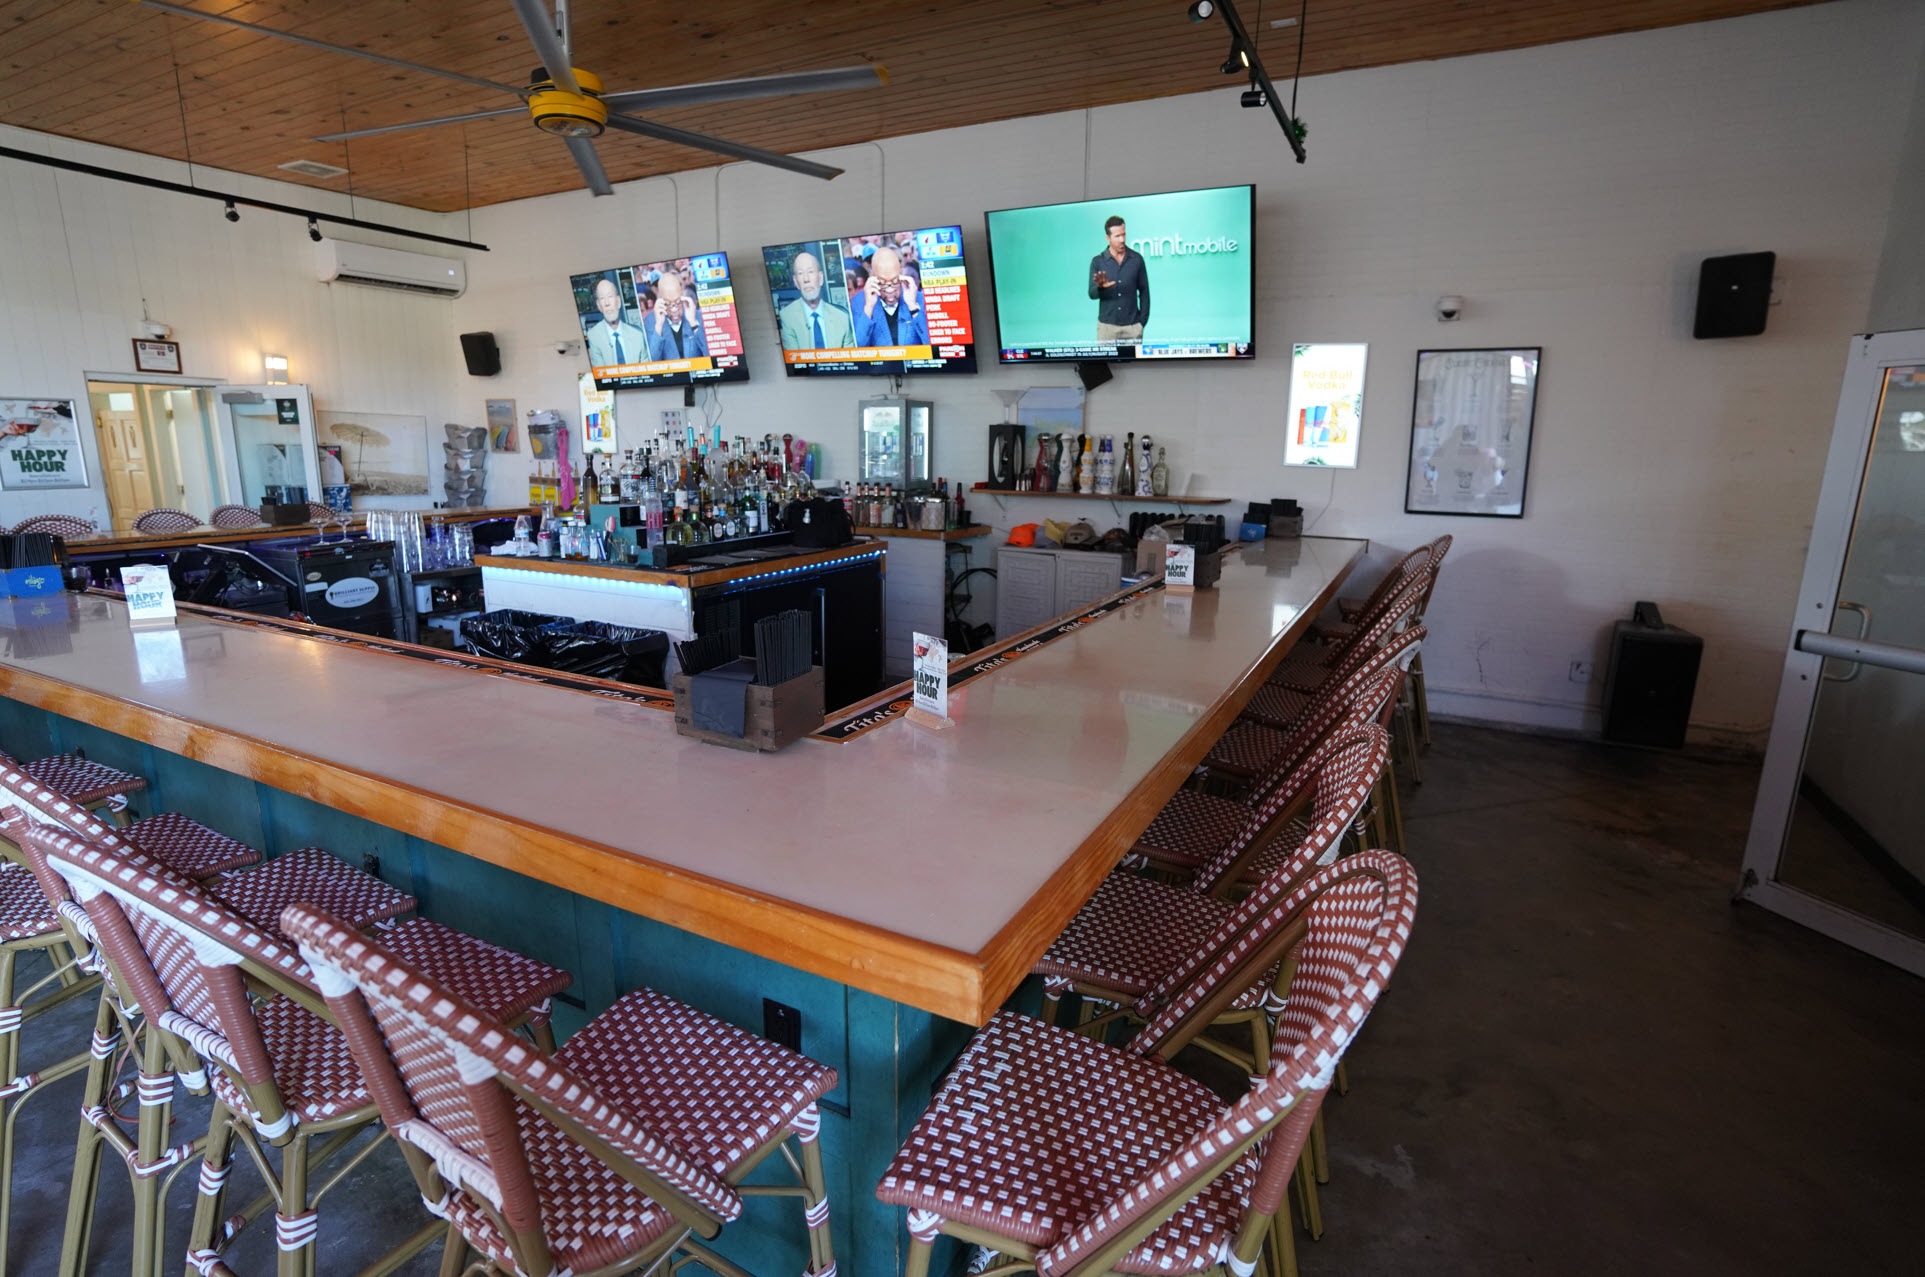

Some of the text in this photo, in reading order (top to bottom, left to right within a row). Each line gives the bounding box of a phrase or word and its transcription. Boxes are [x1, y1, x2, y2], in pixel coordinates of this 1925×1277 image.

[1185, 236, 1238, 254] mobile
[816, 350, 850, 360] COMPELLING
[850, 349, 877, 359] MATCHUP
[1303, 370, 1353, 380] Red Bull
[1308, 381, 1346, 390] Vodka
[10, 450, 68, 462] HAPPY
[20, 461, 66, 472] HOUR
[1166, 564, 1188, 572] HAPPY
[126, 592, 164, 602] HAPPY
[974, 657, 1009, 672] Tito's
[914, 670, 941, 689] HAPPY
[591, 690, 646, 702] Tito's
[916, 683, 938, 700] HOUR
[844, 710, 896, 732] Tito's
